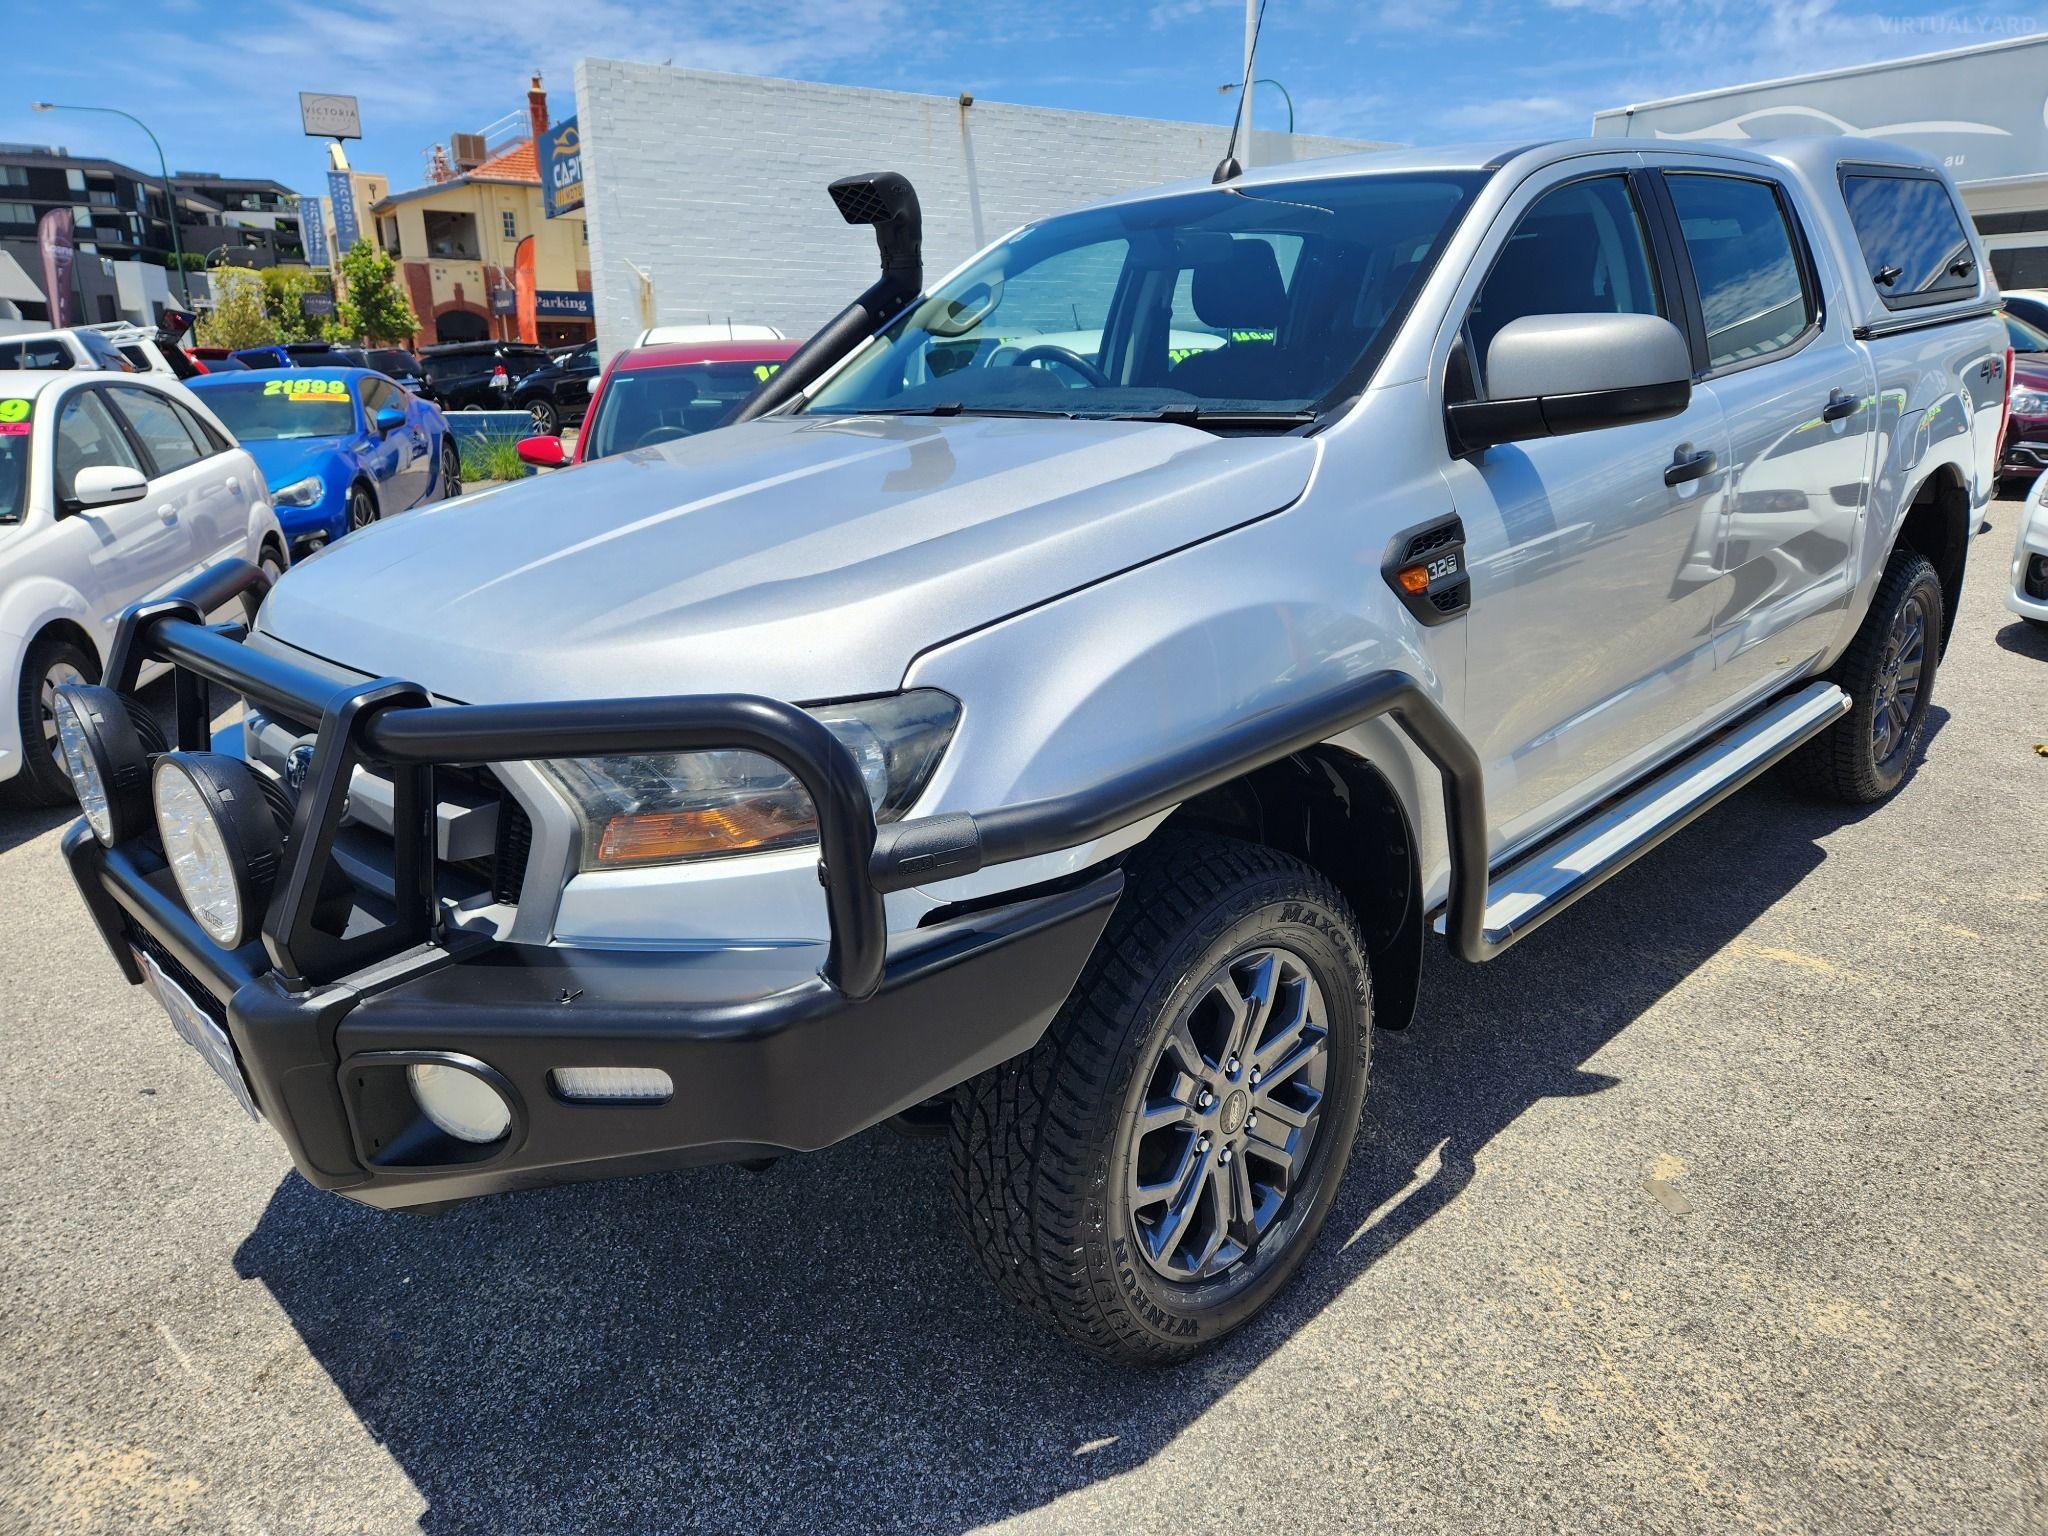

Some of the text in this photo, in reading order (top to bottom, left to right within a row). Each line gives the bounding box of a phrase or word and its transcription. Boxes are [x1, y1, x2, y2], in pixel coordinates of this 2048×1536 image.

[304, 105, 357, 117] VICTORIA
[1944, 154, 1965, 167] au
[338, 175, 353, 233] VICTORIA
[309, 200, 323, 250] VICTORIA
[535, 296, 587, 311] Parking
[263, 379, 345, 396] 21999
[1112, 1237, 1199, 1337] WINRUN
